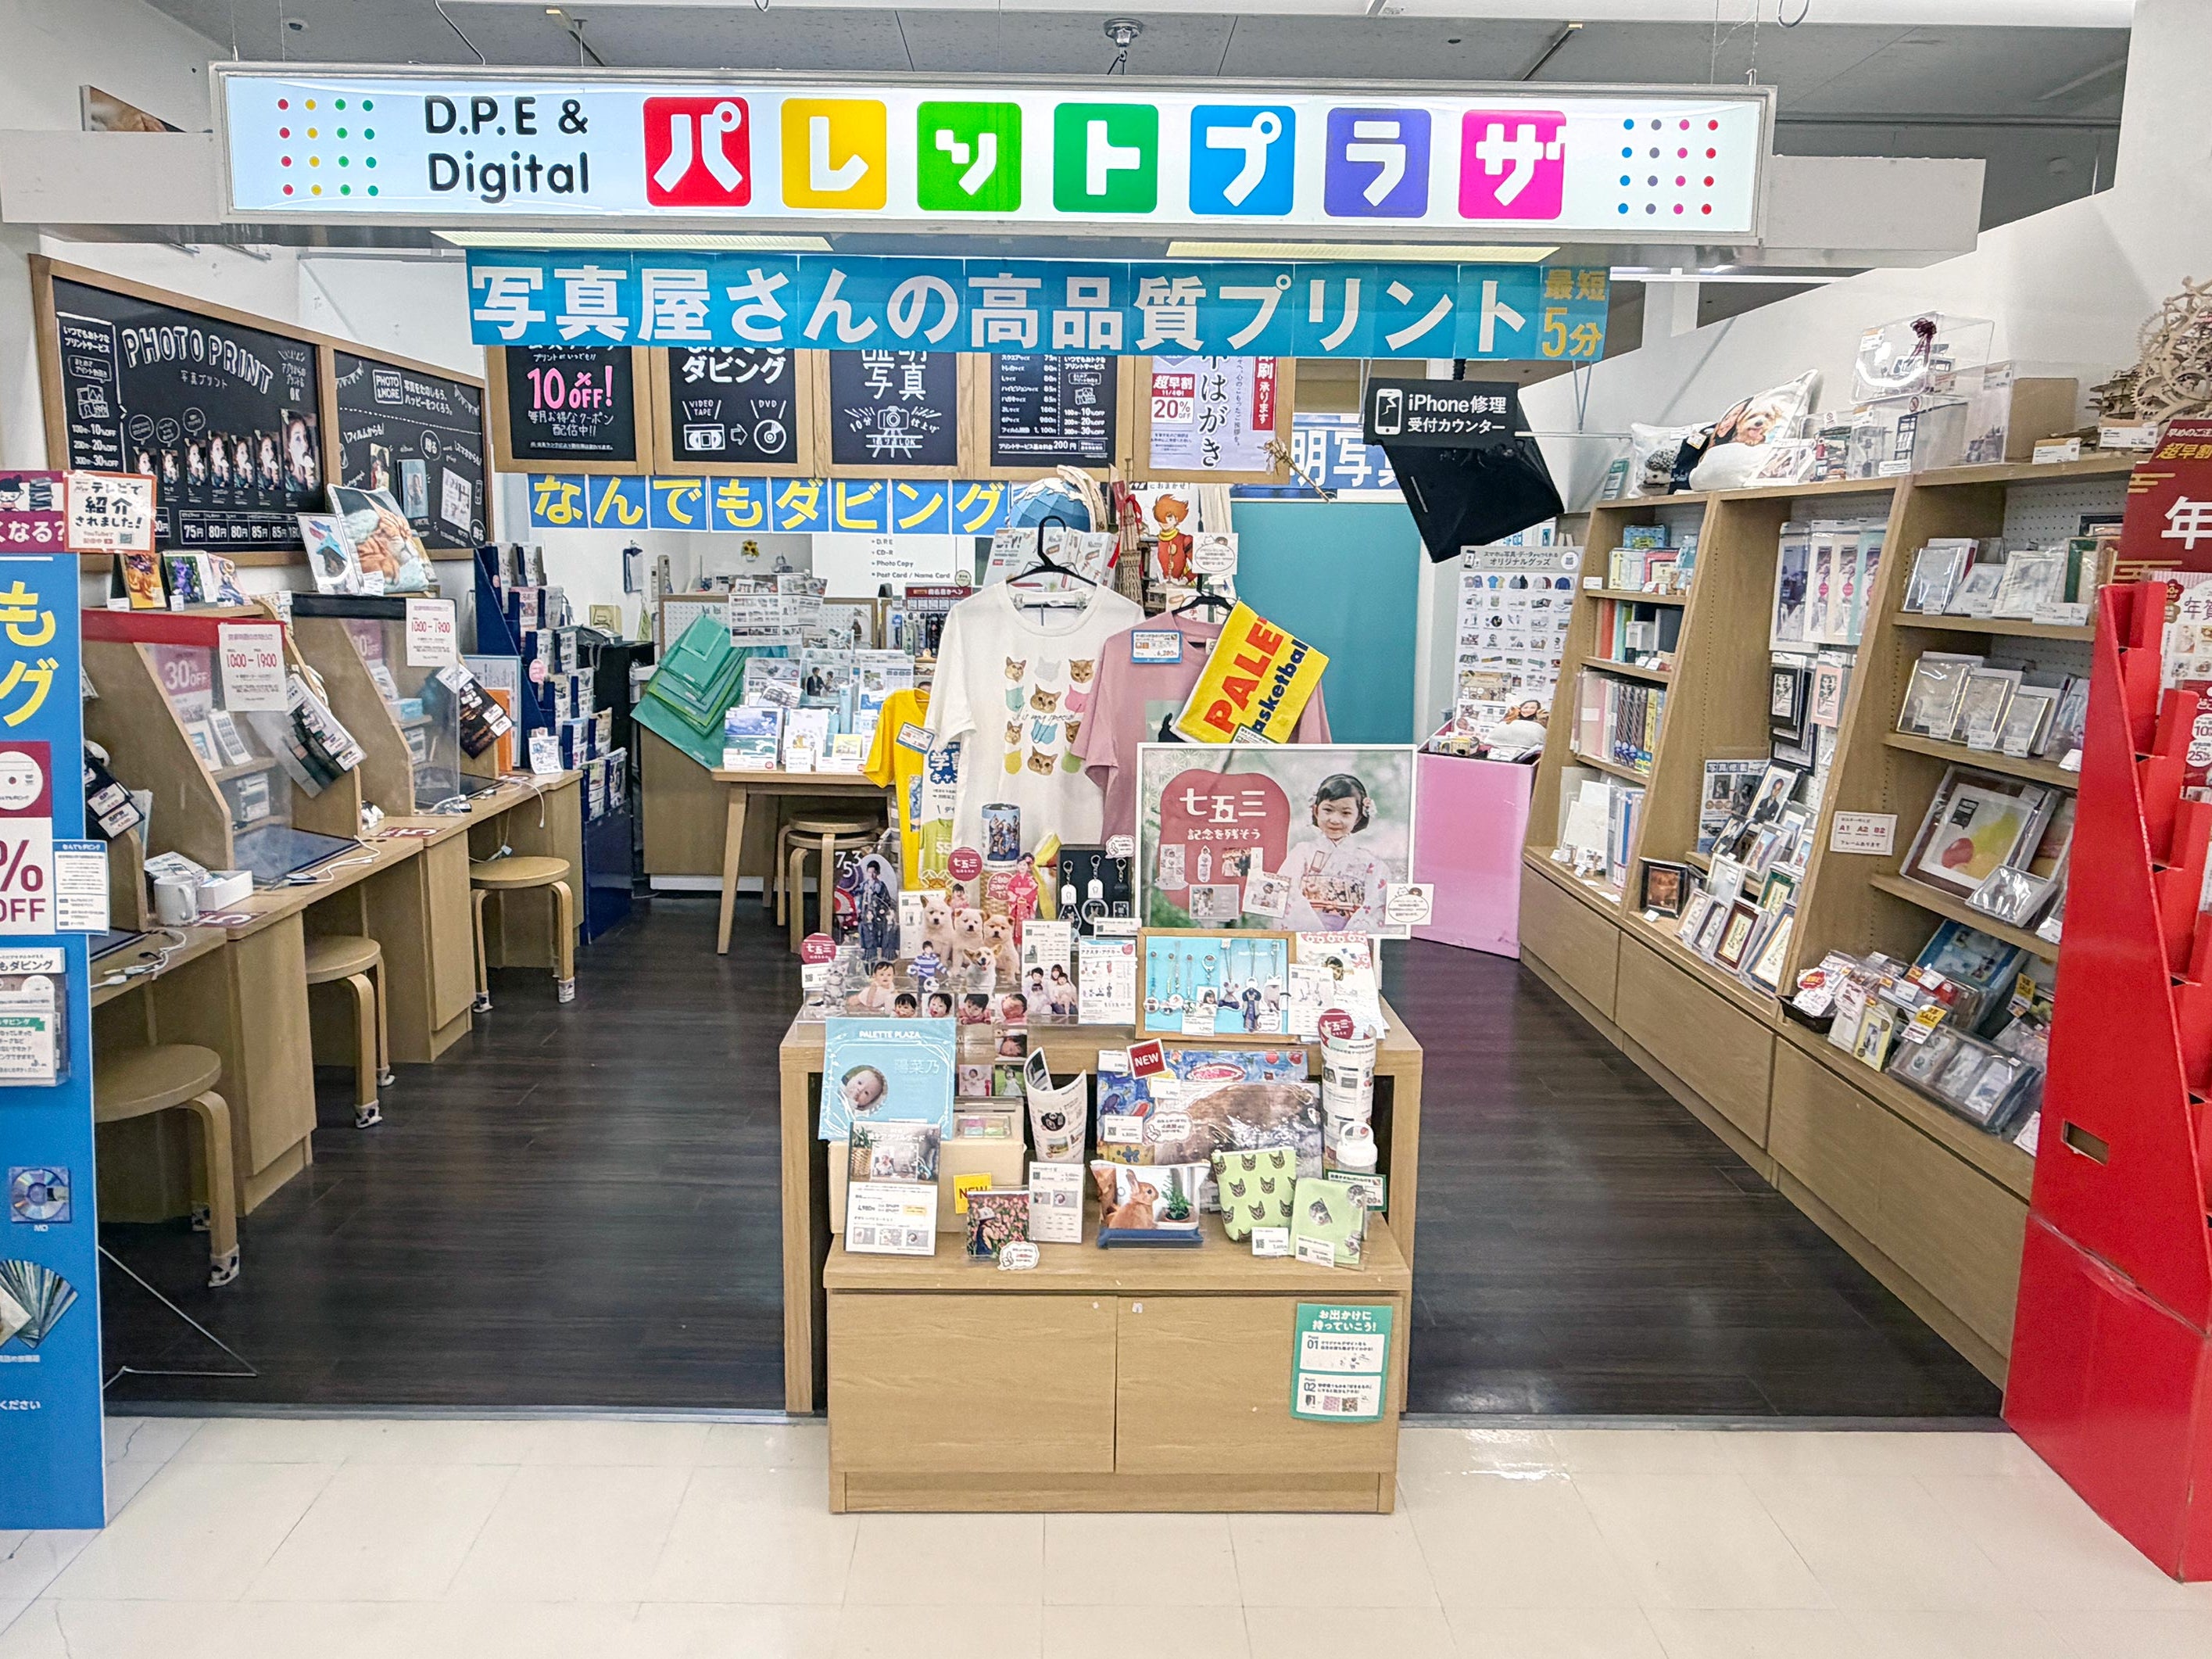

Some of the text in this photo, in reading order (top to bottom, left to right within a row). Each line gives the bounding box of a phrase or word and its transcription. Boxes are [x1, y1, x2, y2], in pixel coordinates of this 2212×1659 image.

[424, 96, 589, 135] D.P.E &
[653, 102, 1566, 206] パレットプラザ
[428, 151, 591, 204] Digital
[1544, 269, 1605, 303] 最短
[473, 266, 1525, 353] 写真屋さんの高品質プリント
[1542, 307, 1603, 357] 5分
[122, 326, 274, 395] PHOTO PRINT
[682, 356, 786, 385] ダビング
[376, 375, 399, 387] PHOTO
[862, 362, 926, 401] 写真
[1153, 374, 1194, 390] 超早割
[689, 400, 714, 408] VIDEO
[1408, 393, 1506, 414] iPhone修理
[693, 408, 713, 417] TAPE
[1408, 417, 1506, 433] 受付カウンター
[84, 496, 133, 516] 紹介
[534, 475, 1006, 534] なんでもダビング
[75, 516, 142, 529] されました!
[1204, 616, 1284, 734] PALE
[1179, 788, 1266, 823] 七五三
[1187, 828, 1261, 841] 記念を残そう
[953, 858, 978, 869] 七五三
[806, 943, 832, 955] 七五三
[894, 1030, 921, 1039] PLAZA
[1134, 1052, 1160, 1066] NEW
[1319, 1310, 1373, 1320] お出かけに
[1312, 1320, 1376, 1332] 持っていこう!
[1307, 1339, 1319, 1349] 01
[1304, 1382, 1316, 1392] 02
